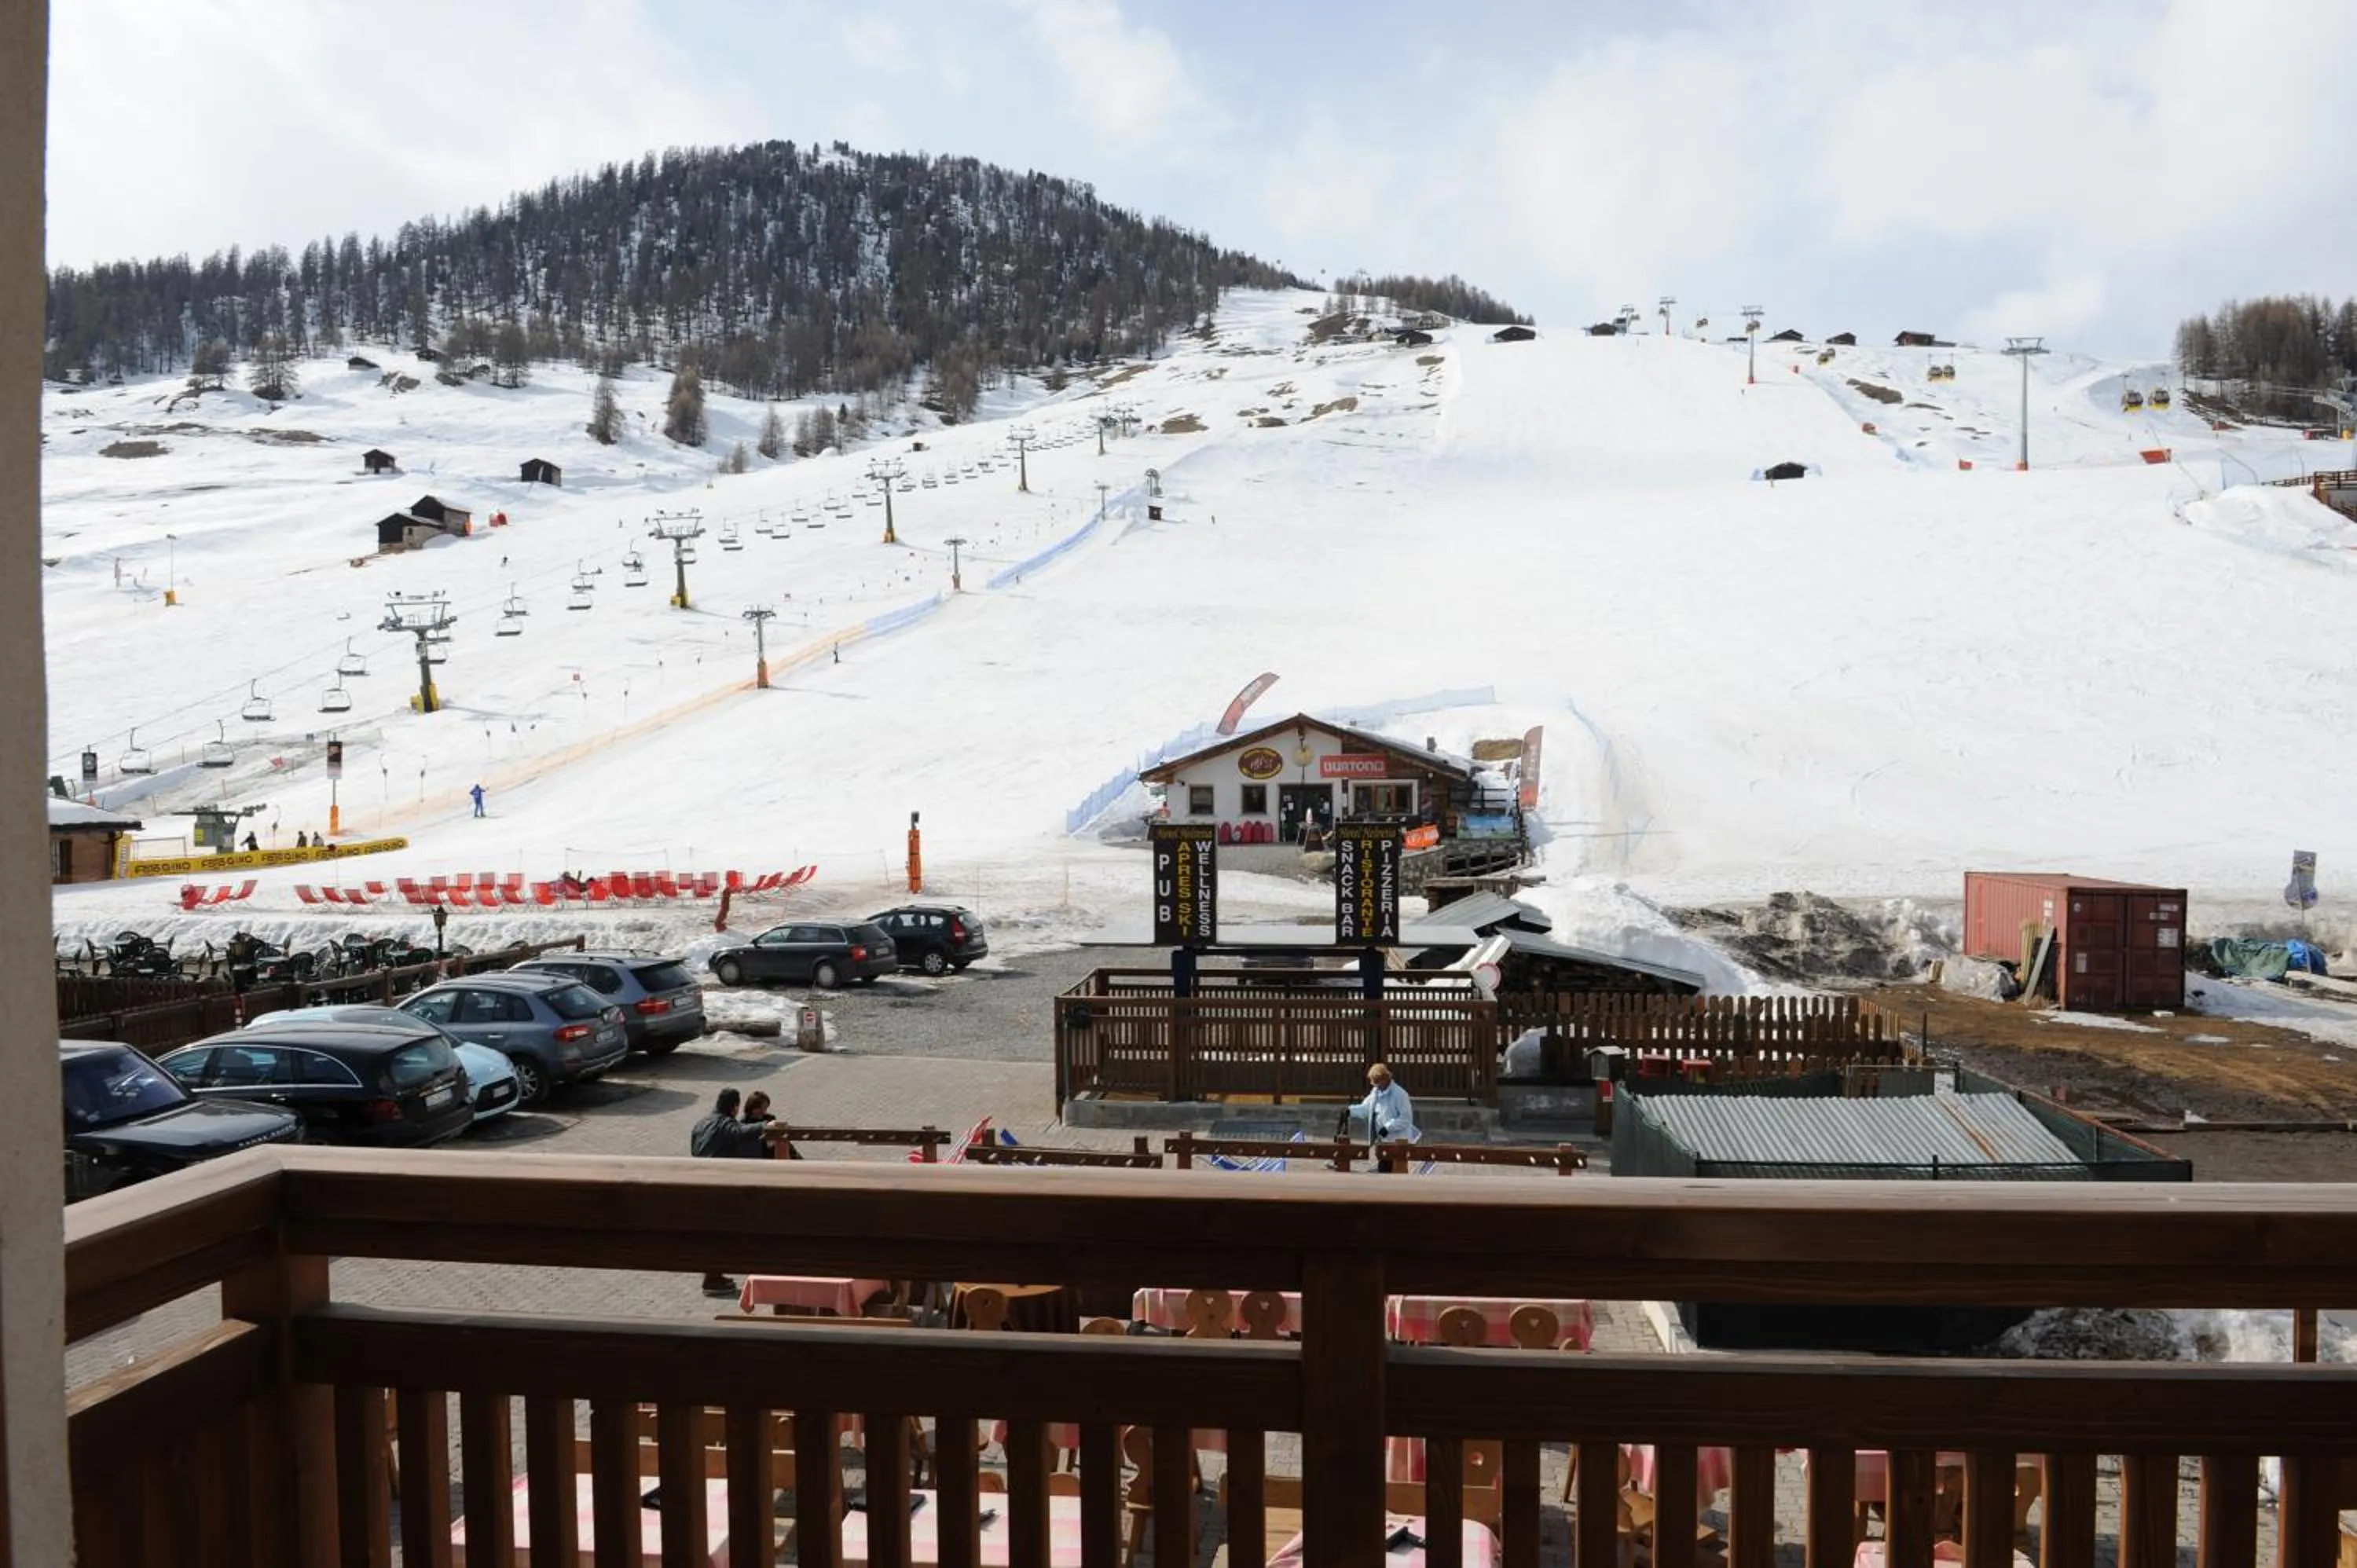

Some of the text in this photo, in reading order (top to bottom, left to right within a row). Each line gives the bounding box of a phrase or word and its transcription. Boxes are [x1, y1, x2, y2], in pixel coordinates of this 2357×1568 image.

[1159, 854, 1171, 922] PUB
[1178, 841, 1192, 937] APRES SKI
[1195, 841, 1212, 936] WELLNESS
[1341, 840, 1354, 937] SNACK BAR
[1360, 840, 1374, 937] RISTORANTE
[1380, 840, 1394, 937] PIZZERIA
